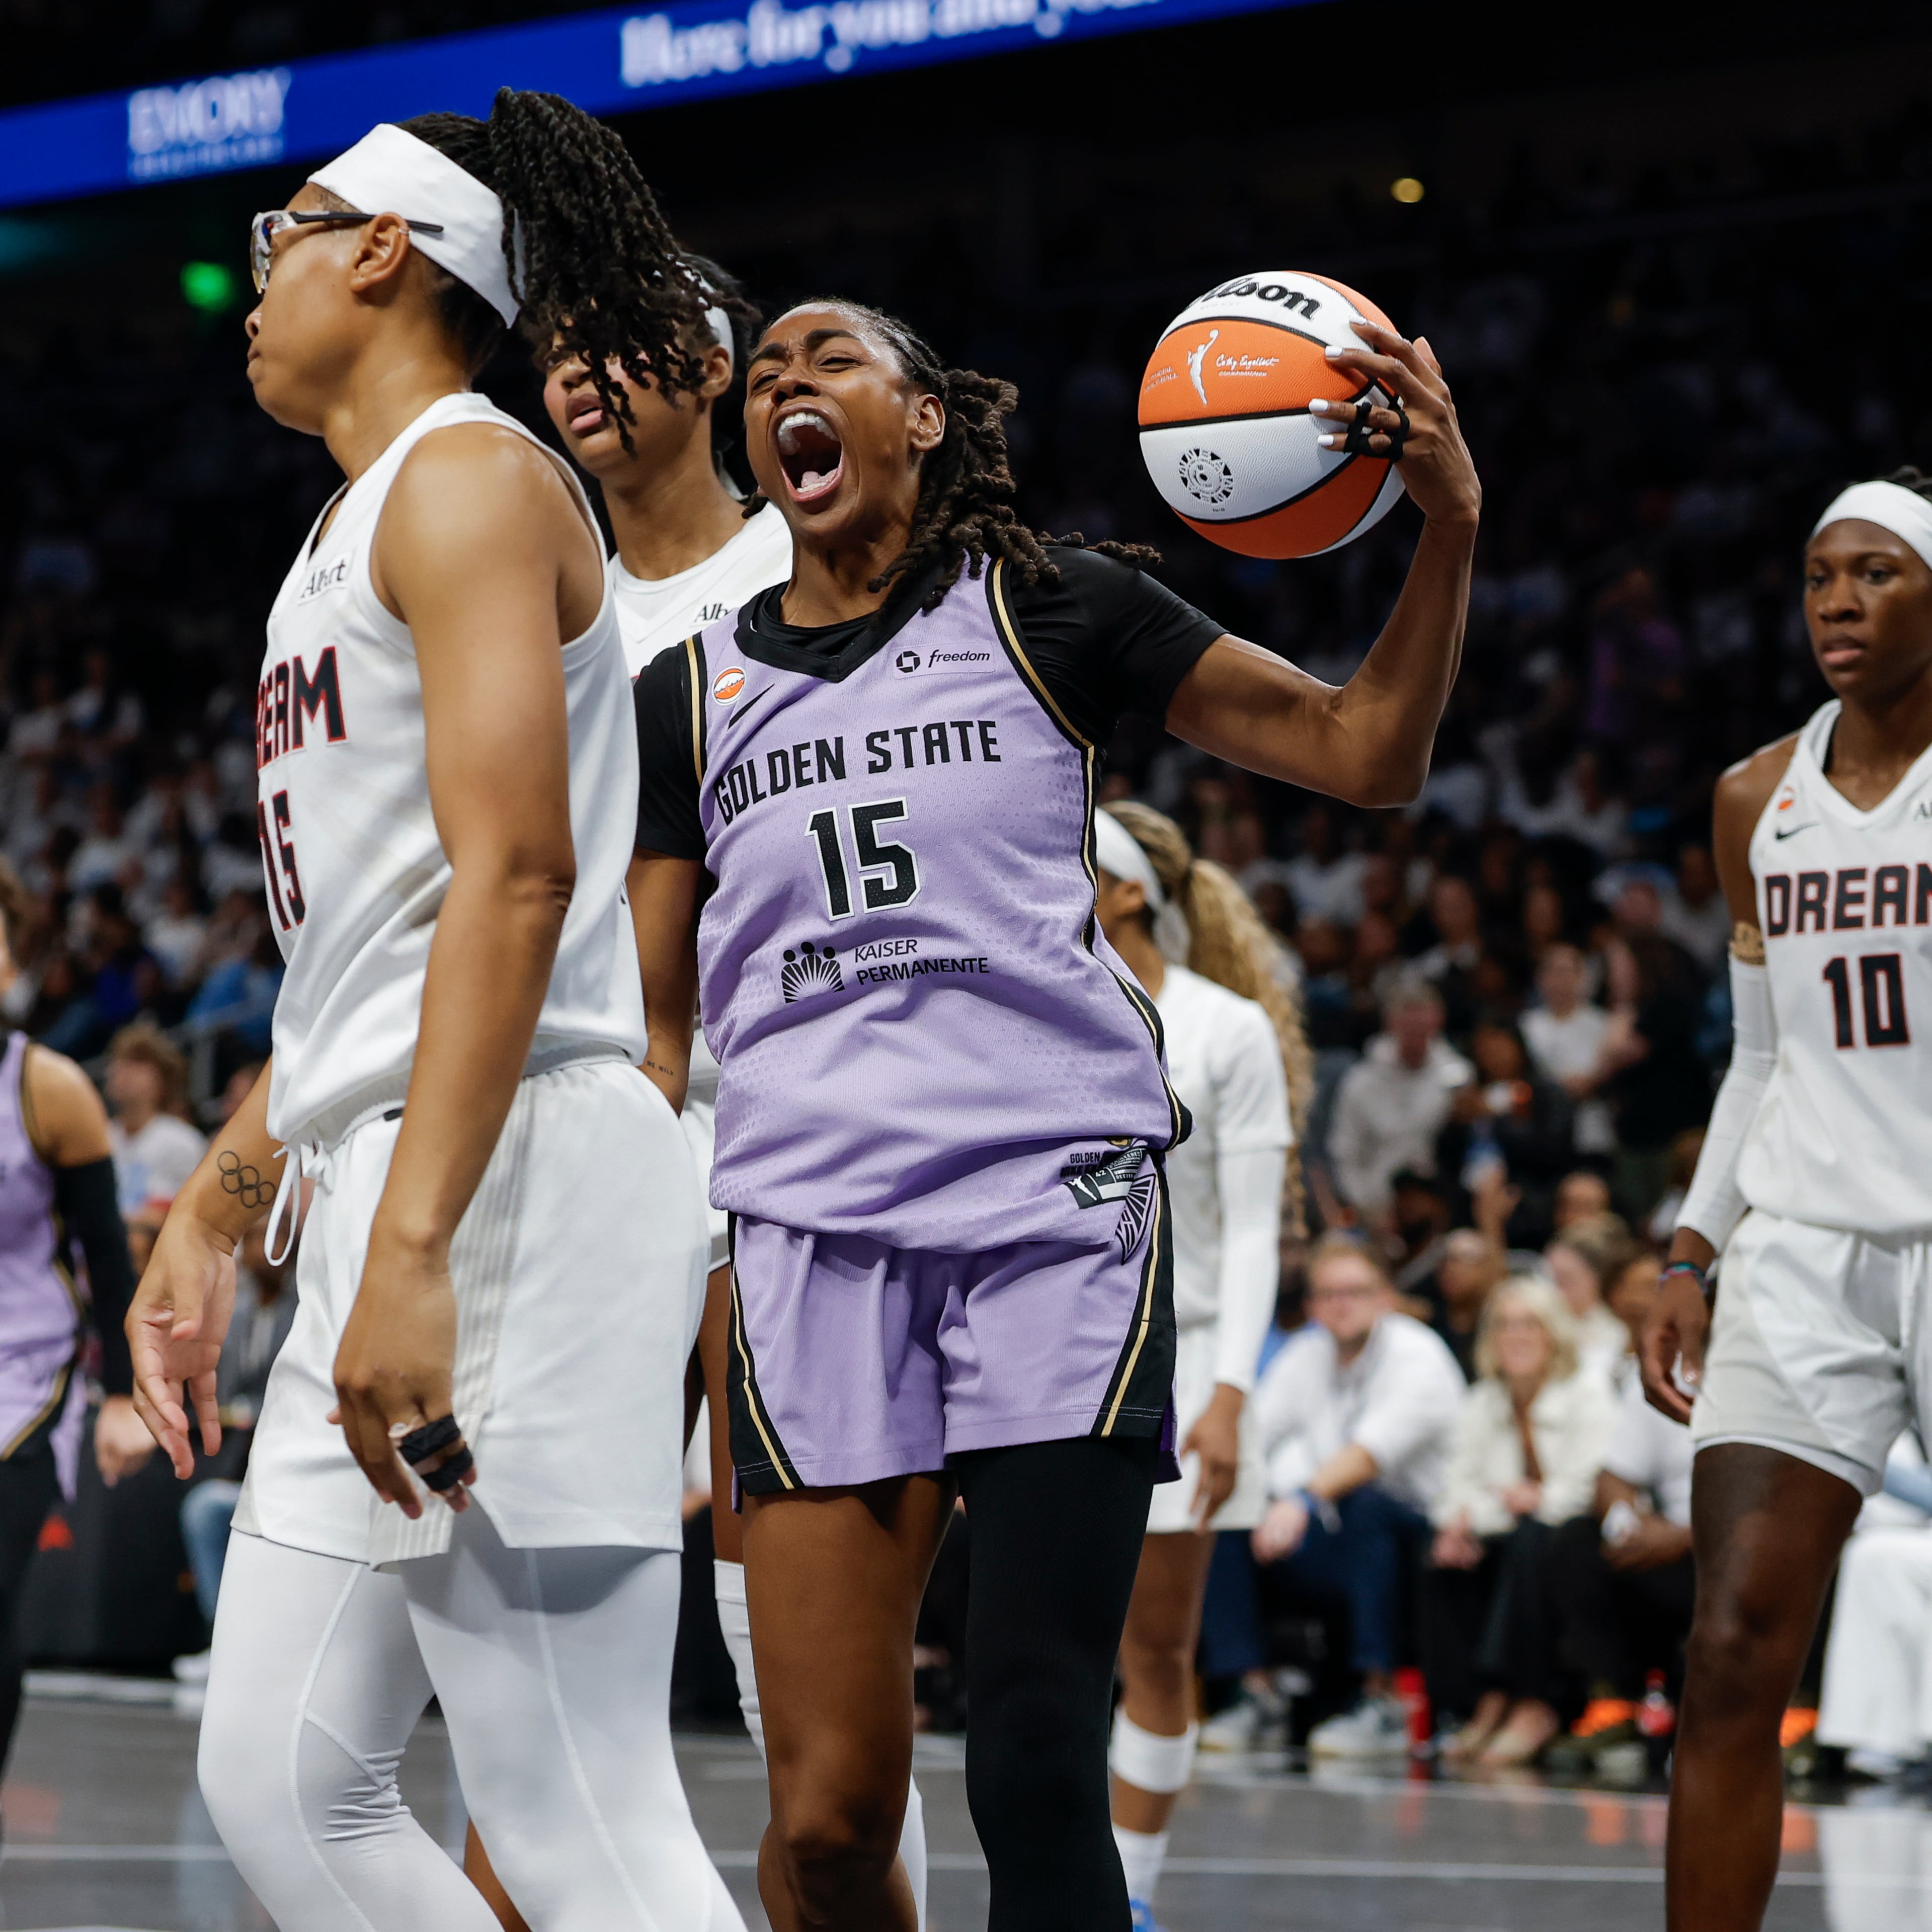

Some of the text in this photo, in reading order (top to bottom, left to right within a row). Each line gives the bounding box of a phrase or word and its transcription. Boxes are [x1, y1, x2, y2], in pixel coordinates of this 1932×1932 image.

[1183, 276, 1323, 322] ilson
[694, 602, 733, 623] Alb
[928, 649, 990, 668] freedom
[713, 720, 1001, 826] GOLDEN STATE
[805, 796, 921, 921] 15
[855, 939, 918, 963] KAISER
[856, 957, 990, 985] PERMANENTE
[1822, 954, 1910, 1050] 10
[1070, 1152, 1100, 1164] GOLDEN
